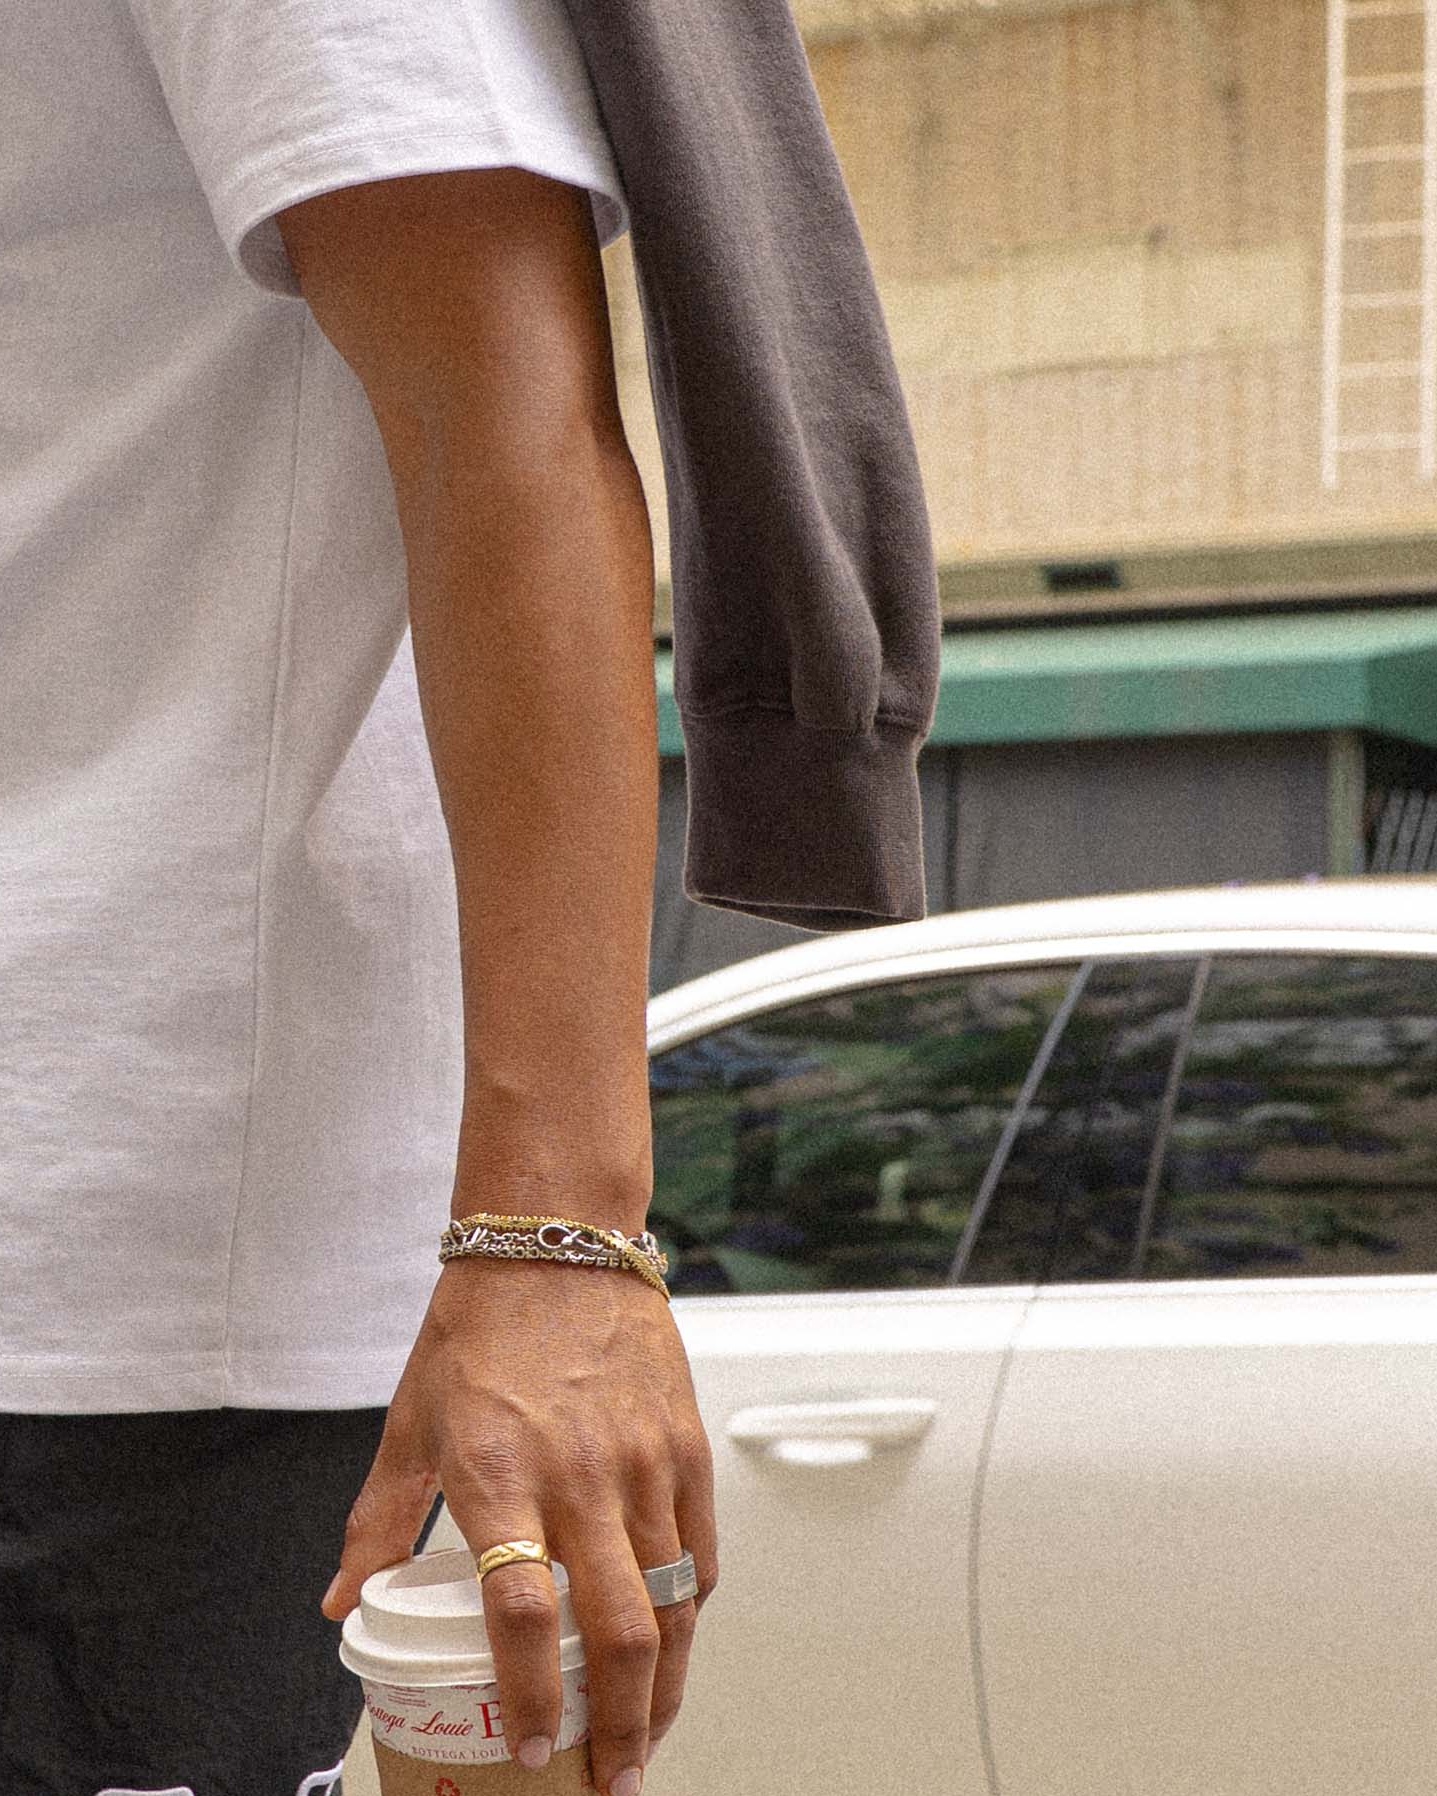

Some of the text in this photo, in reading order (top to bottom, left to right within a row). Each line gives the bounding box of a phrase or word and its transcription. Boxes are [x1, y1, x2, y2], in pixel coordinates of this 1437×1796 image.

[411, 1710, 473, 1737] Louie
[411, 1745, 508, 1761] BOTTEGA LOUI
